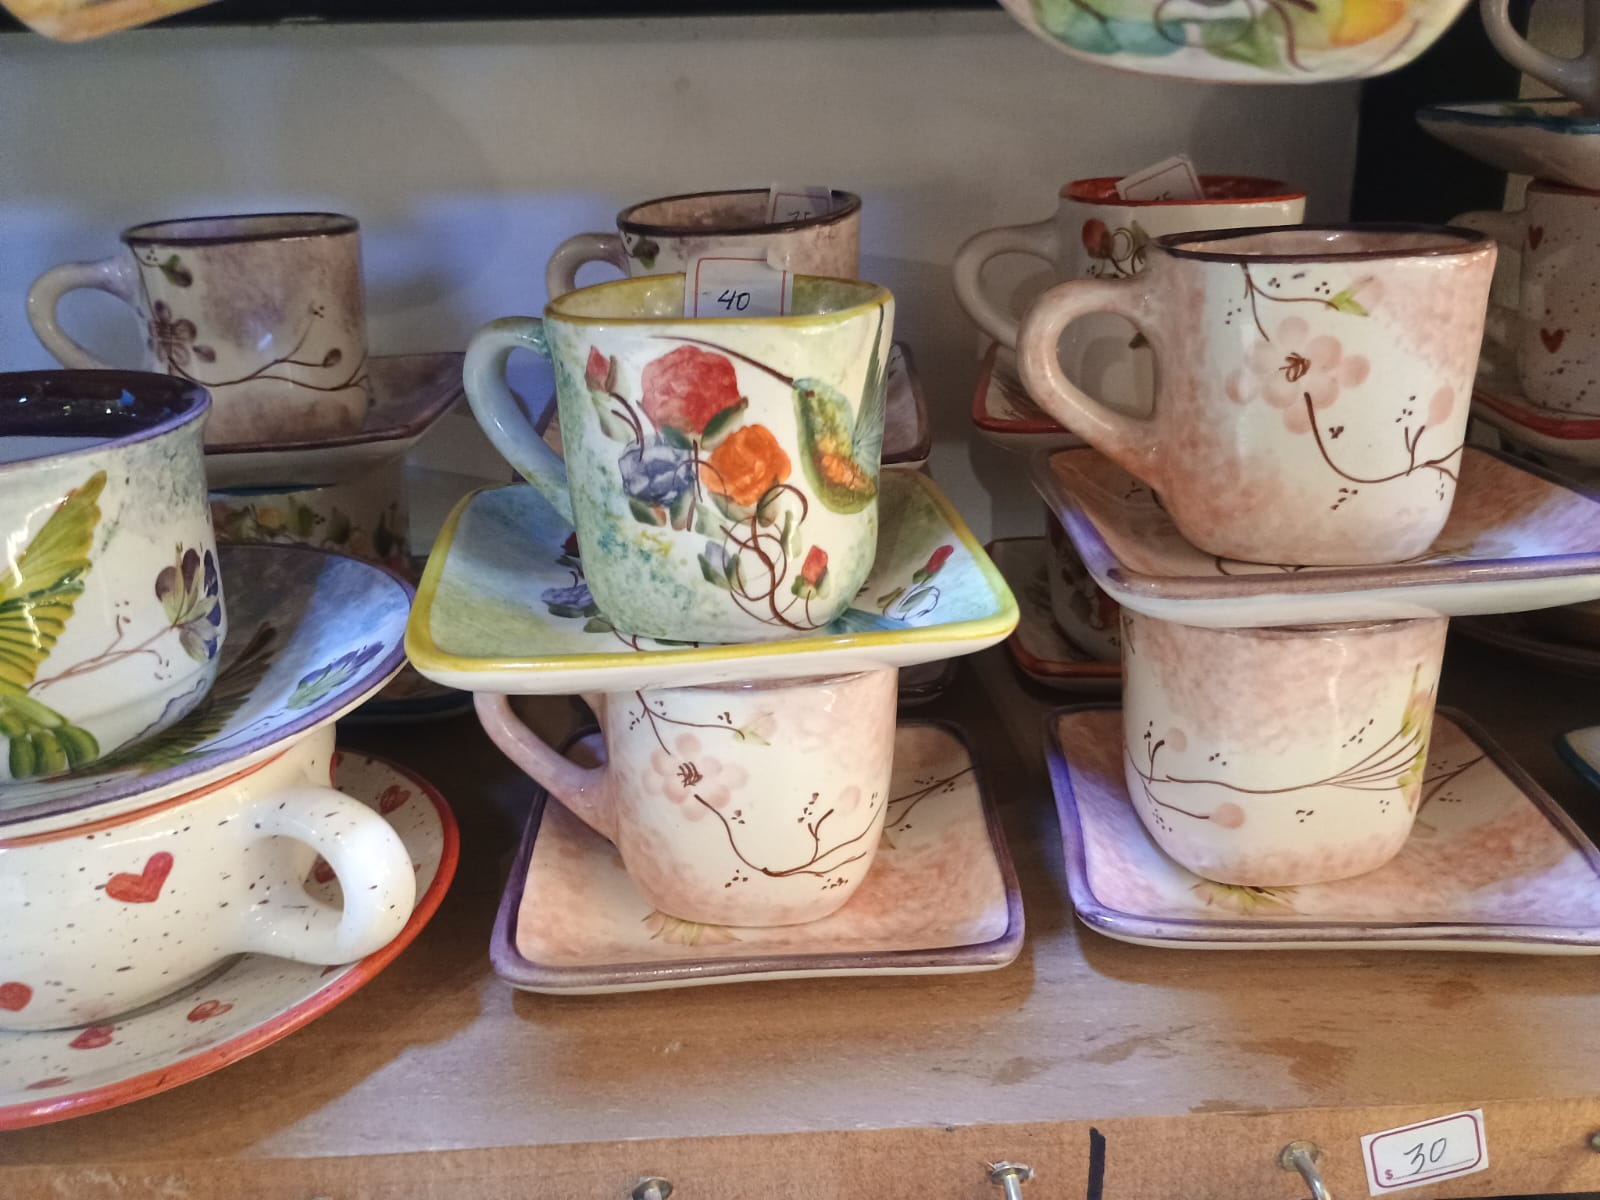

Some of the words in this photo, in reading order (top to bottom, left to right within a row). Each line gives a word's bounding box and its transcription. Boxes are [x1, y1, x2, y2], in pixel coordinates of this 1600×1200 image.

[717, 289, 751, 311] 40
[1384, 1169, 1394, 1181] $
[1403, 1137, 1447, 1175] 30
